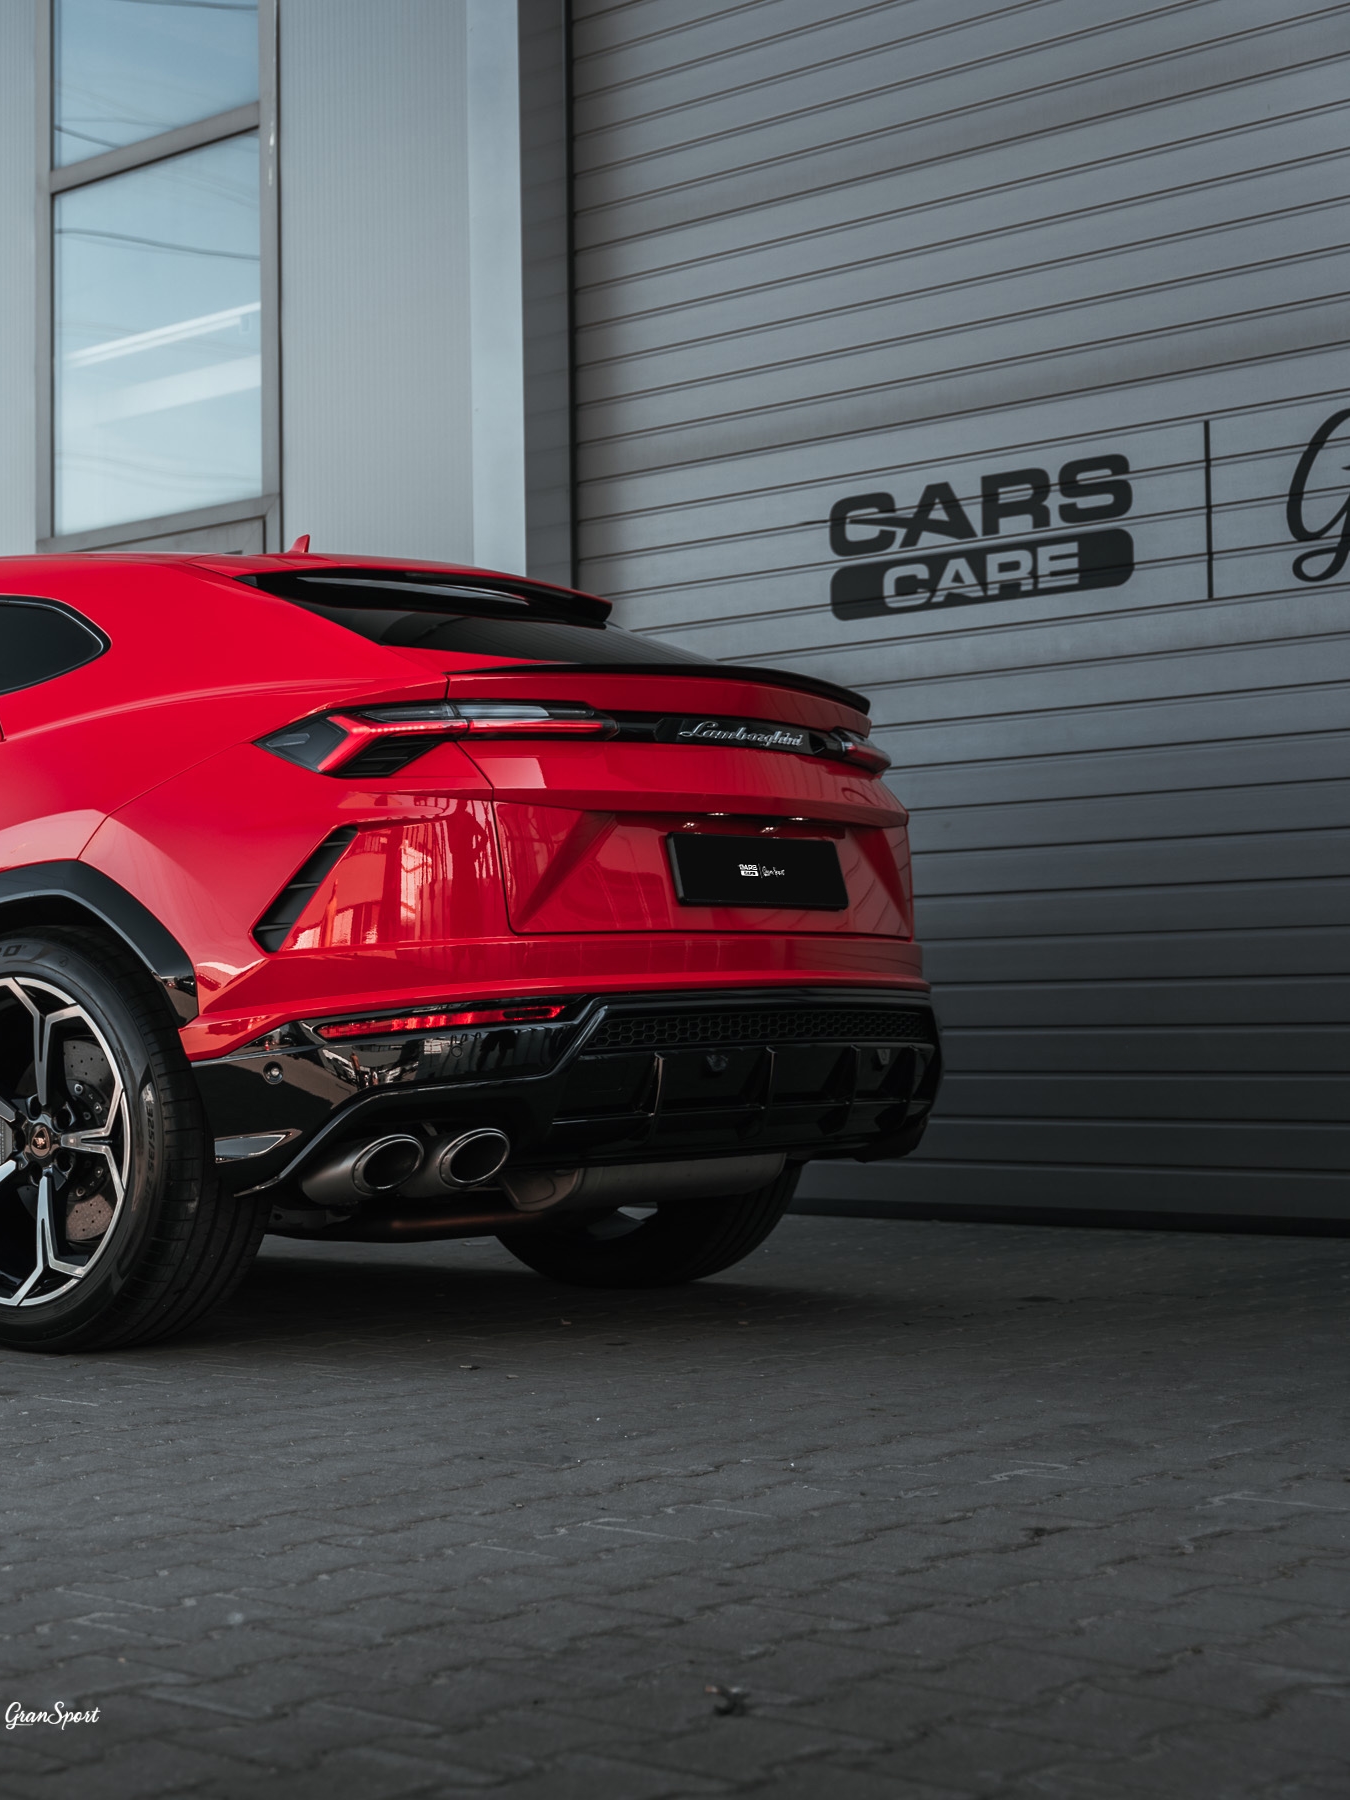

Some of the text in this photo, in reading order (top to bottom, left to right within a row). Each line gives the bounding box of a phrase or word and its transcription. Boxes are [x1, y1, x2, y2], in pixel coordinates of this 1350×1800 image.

[829, 453, 1133, 557] CARS
[881, 541, 1080, 609] CARE
[678, 720, 804, 747] Lamborghini
